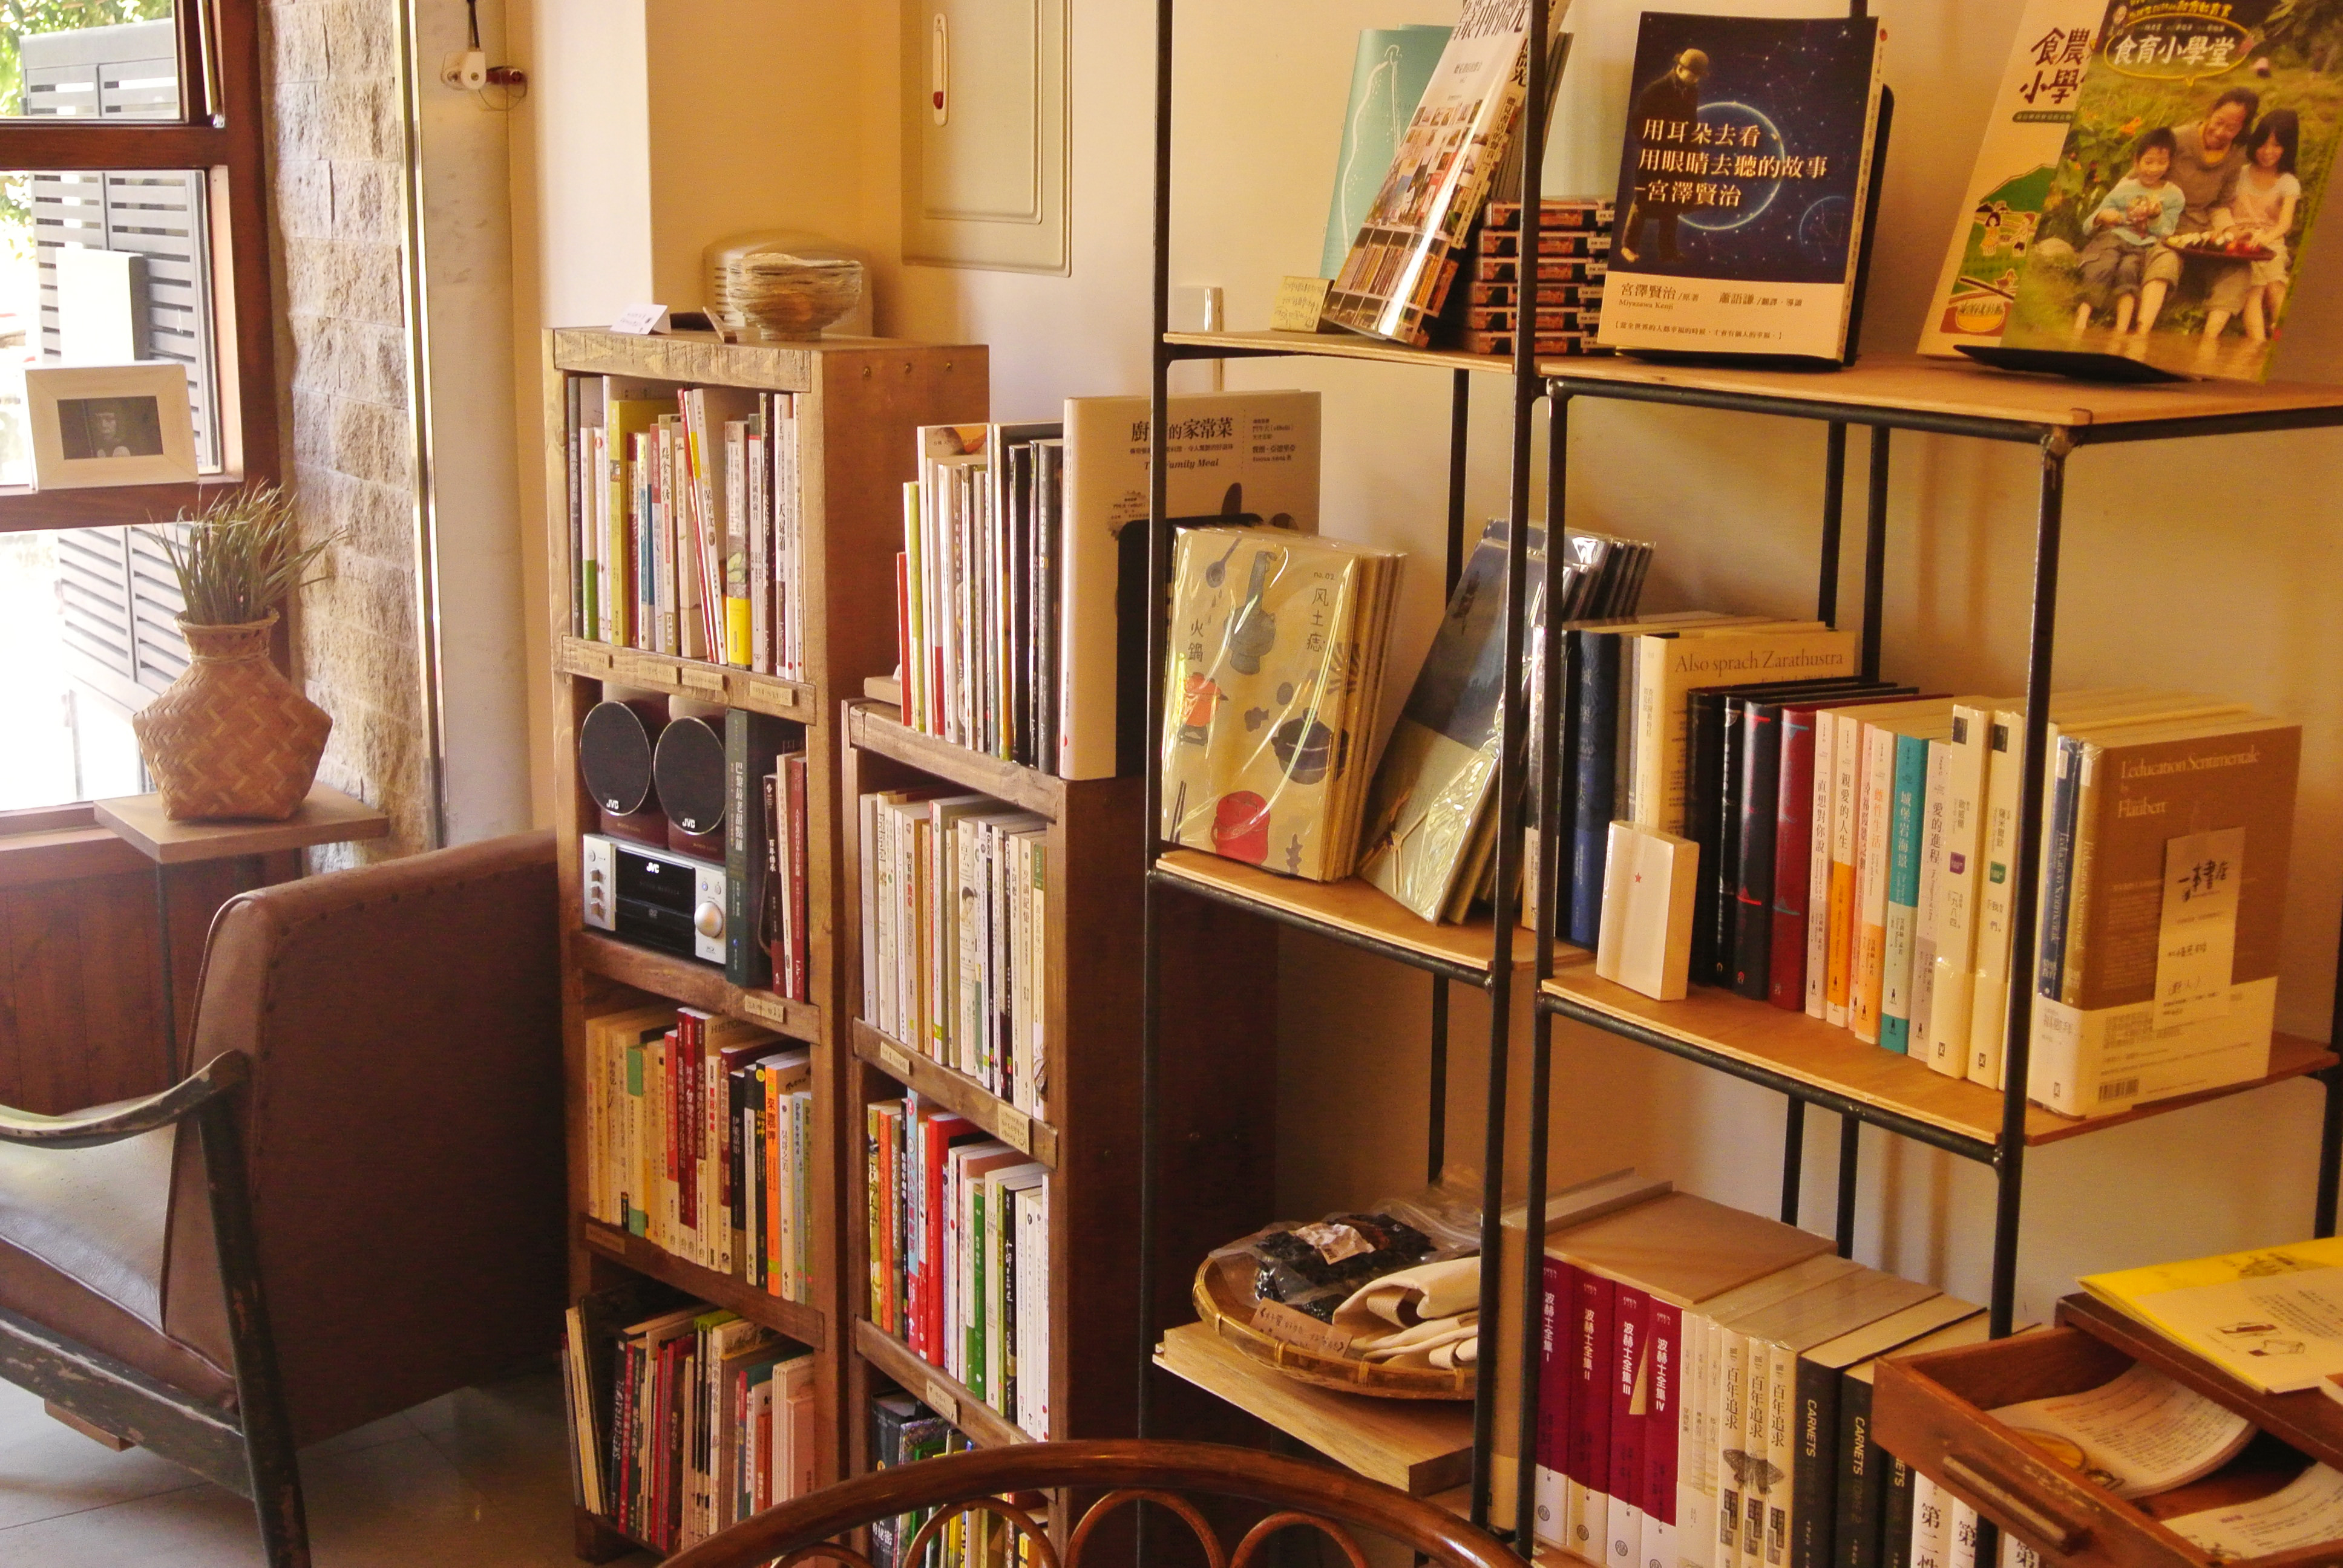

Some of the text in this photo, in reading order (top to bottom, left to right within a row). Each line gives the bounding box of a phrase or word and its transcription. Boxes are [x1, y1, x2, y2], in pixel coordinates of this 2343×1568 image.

[2114, 34, 2236, 67] 食育小學堂
[2019, 68, 2085, 104] 小學
[1642, 119, 1761, 147] 用耳朵去看
[1638, 148, 1828, 179] 用眼睛去聽的故事
[1619, 298, 1653, 310] Miyazawa
[1131, 417, 1234, 442] 廚的家常菜
[1165, 458, 1219, 470] amily Meal
[1188, 618, 1204, 662] 火鍋
[1675, 648, 1843, 677] Also sprach Zarathustra
[606, 799, 619, 809] JVC
[1815, 771, 1827, 854] 一直想對你說
[1838, 773, 1851, 850] 親愛的人生
[682, 818, 695, 829] JVC
[1897, 791, 1912, 868] 城堡岩海景
[1930, 802, 1943, 863] 愛的進程
[646, 862, 660, 874] JVC
[1725, 1367, 1739, 1430] 百年追求
[1749, 1376, 1763, 1439] 百年追求
[1771, 1384, 1786, 1448] 百年追求
[1806, 1399, 1818, 1458] CARNETS
[1853, 1416, 1866, 1476] CARNETS
